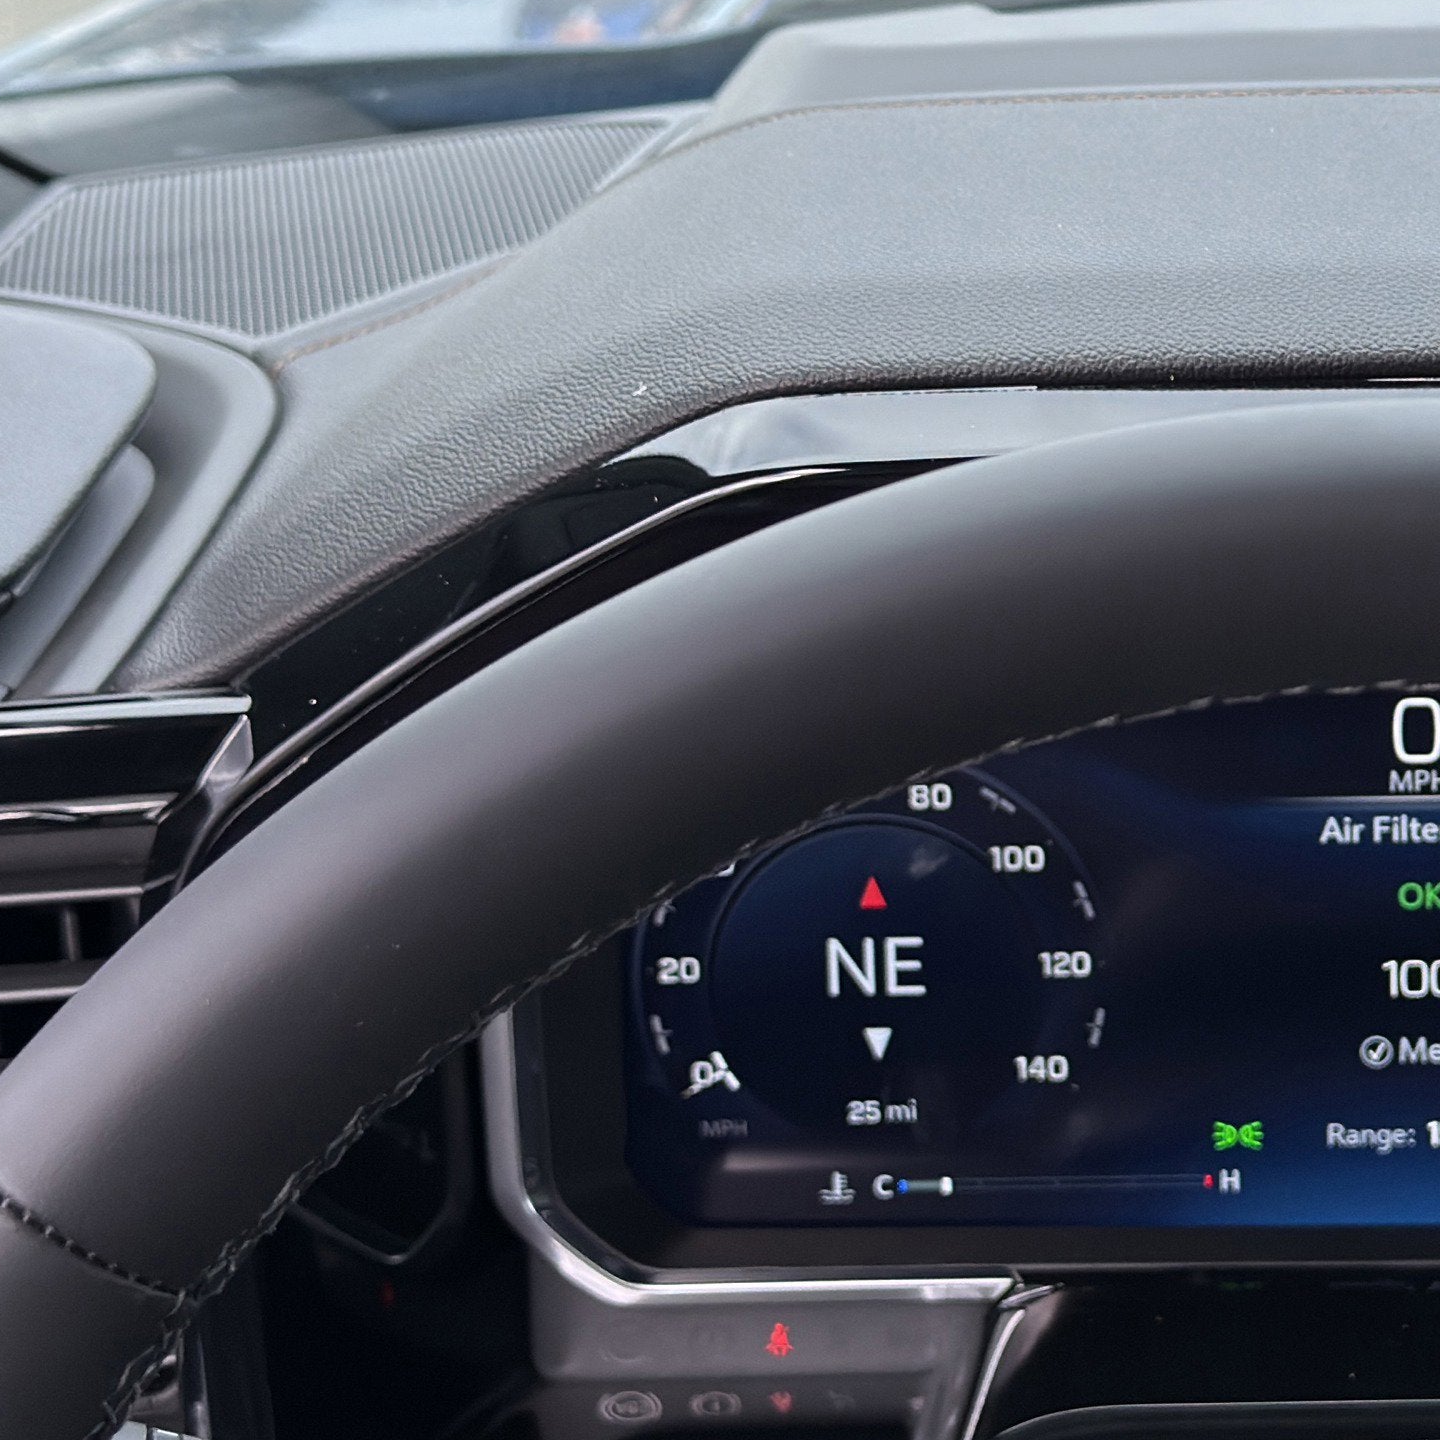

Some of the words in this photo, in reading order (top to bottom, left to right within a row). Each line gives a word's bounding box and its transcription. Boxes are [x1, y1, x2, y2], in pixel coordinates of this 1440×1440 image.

[907, 783, 953, 812] 80
[1319, 815, 1366, 844] Air
[989, 844, 1046, 873] 100
[656, 956, 701, 986] 20
[825, 936, 928, 997] NE
[1038, 950, 1093, 978] 120
[1013, 1054, 1070, 1082] 140
[846, 1099, 881, 1125] 25
[886, 1098, 919, 1123] mi
[700, 1118, 749, 1138] MPH
[1326, 1122, 1417, 1156] Range:
[872, 1173, 894, 1201] C
[1219, 1168, 1242, 1193] H
